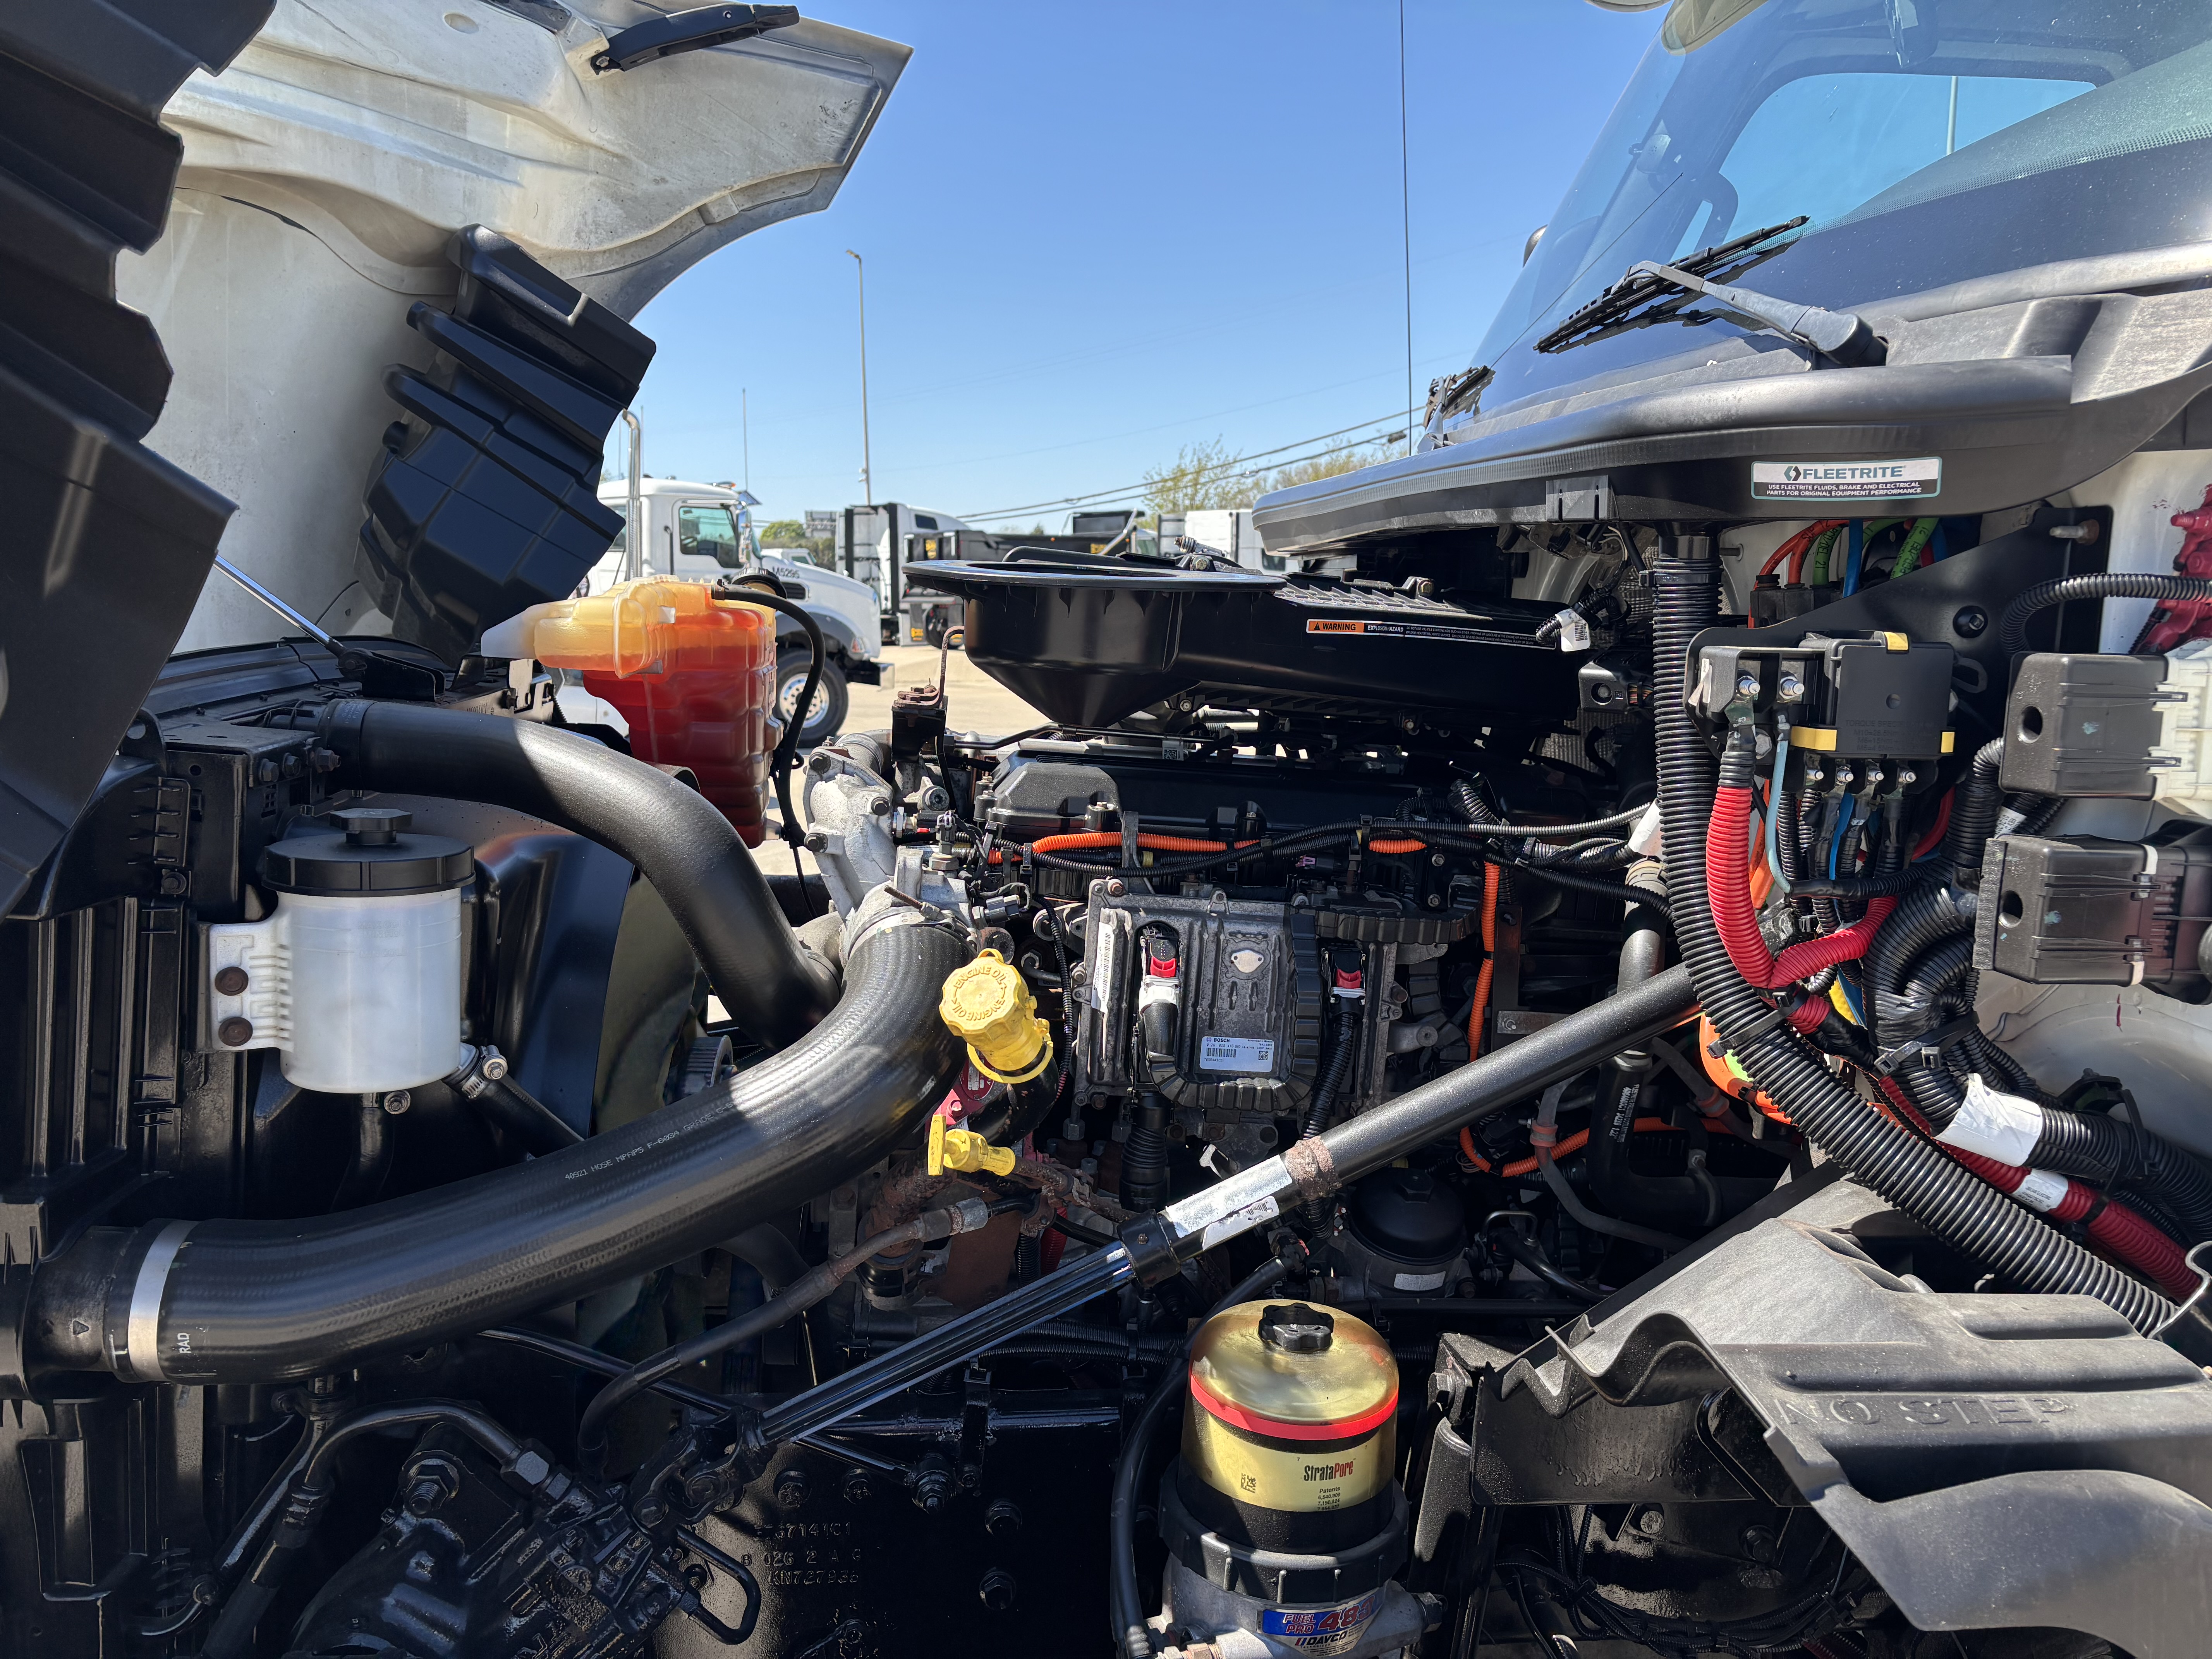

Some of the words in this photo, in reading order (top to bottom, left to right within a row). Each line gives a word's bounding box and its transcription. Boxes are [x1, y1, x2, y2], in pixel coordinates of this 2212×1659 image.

[1803, 466, 1903, 479] FLEETRITE
[1871, 487, 1922, 495] PERFORMANCE
[1322, 622, 1356, 631] WARNING
[953, 966, 991, 989] ENGINE
[992, 969, 1006, 985] OIL
[952, 1001, 967, 1017] OIL
[966, 999, 1005, 1021] ENGINE
[565, 1169, 588, 1180] 40921
[591, 1159, 613, 1171] HOSE
[615, 1147, 644, 1163] MPAPS
[647, 1130, 680, 1149] F-6034
[683, 1113, 714, 1131] GRADE
[177, 1333, 191, 1353] RAD
[1774, 1398, 1880, 1425] NO
[1899, 1397, 2066, 1425] STEP
[1304, 1460, 1353, 1482] StrataPore
[1283, 1613, 1316, 1624] FUEL
[1317, 1595, 1375, 1632] 483
[1285, 1624, 1315, 1634] PRO
[1306, 1630, 1348, 1645] DAVCO
